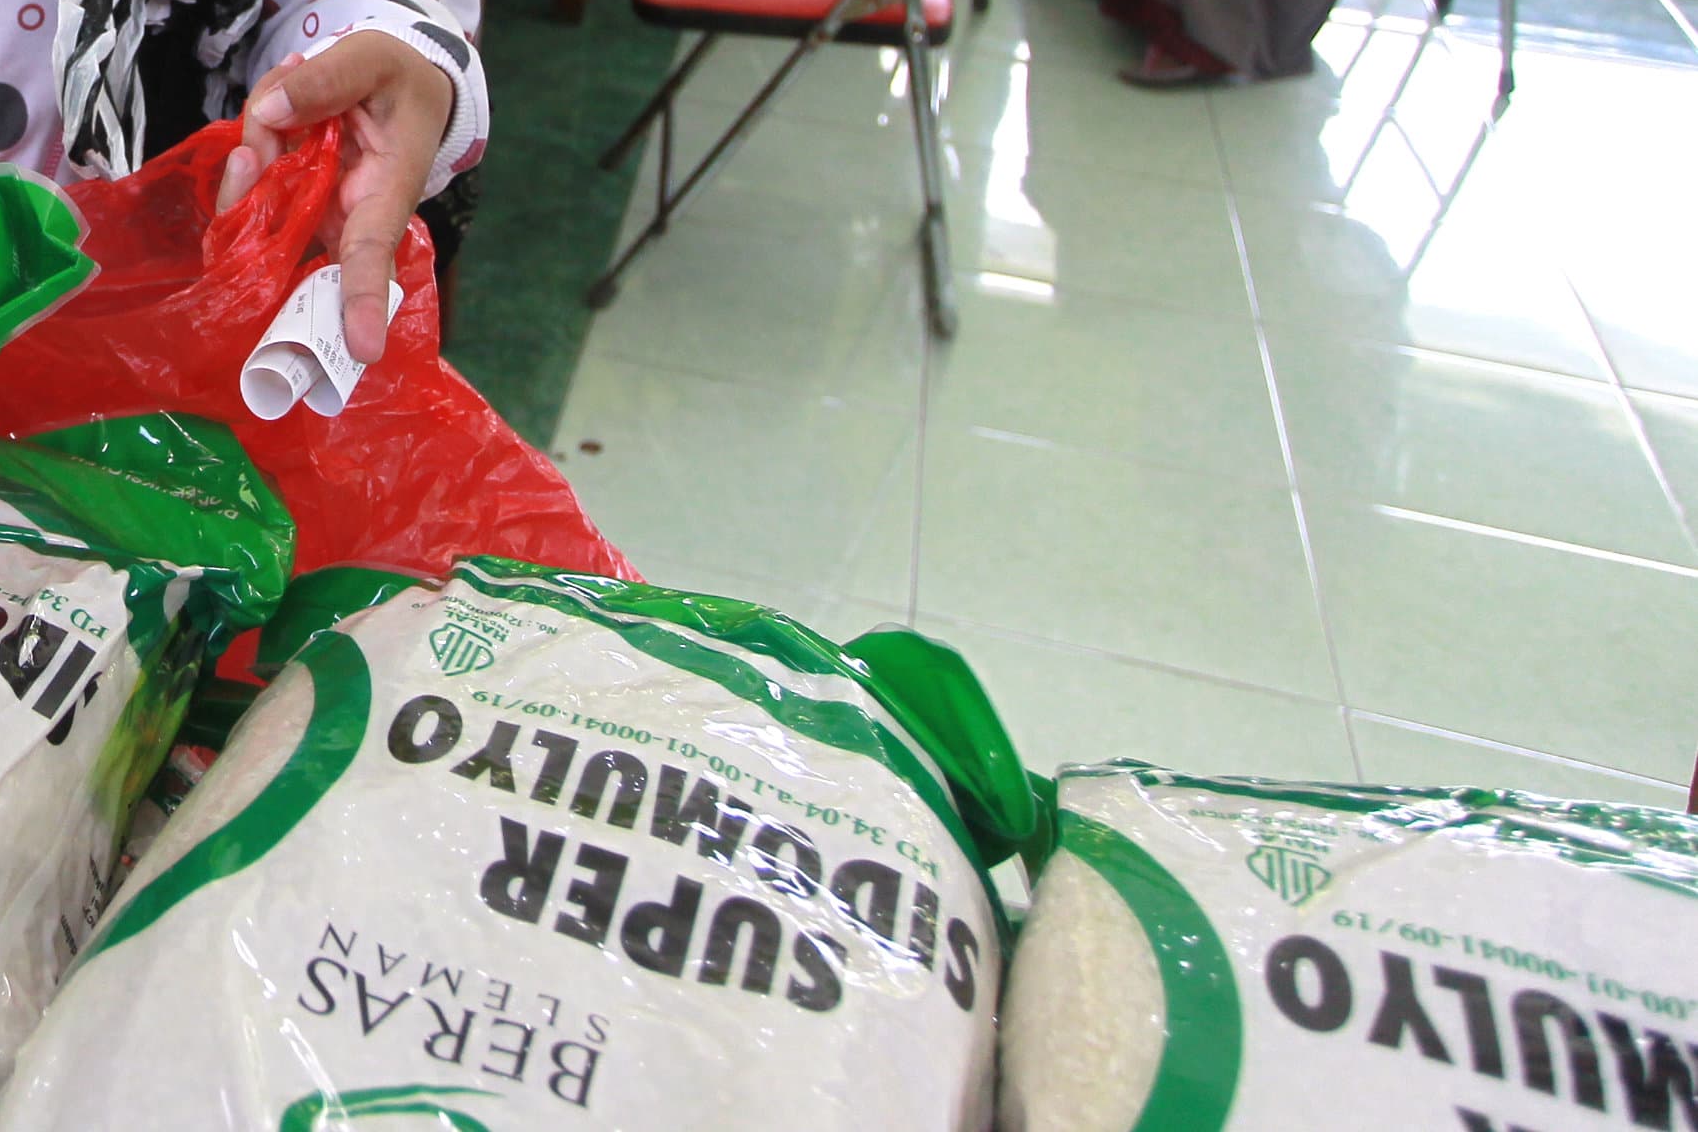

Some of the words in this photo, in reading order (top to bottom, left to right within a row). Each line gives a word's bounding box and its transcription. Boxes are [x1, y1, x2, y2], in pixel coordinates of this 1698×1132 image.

[68, 605, 109, 640] PD
[443, 610, 508, 644] HALAL
[387, 695, 982, 1012] SIDOMULYO
[479, 815, 847, 1013] SUPER
[297, 955, 601, 1108] BERAS
[319, 922, 612, 1044] SLEMAN
